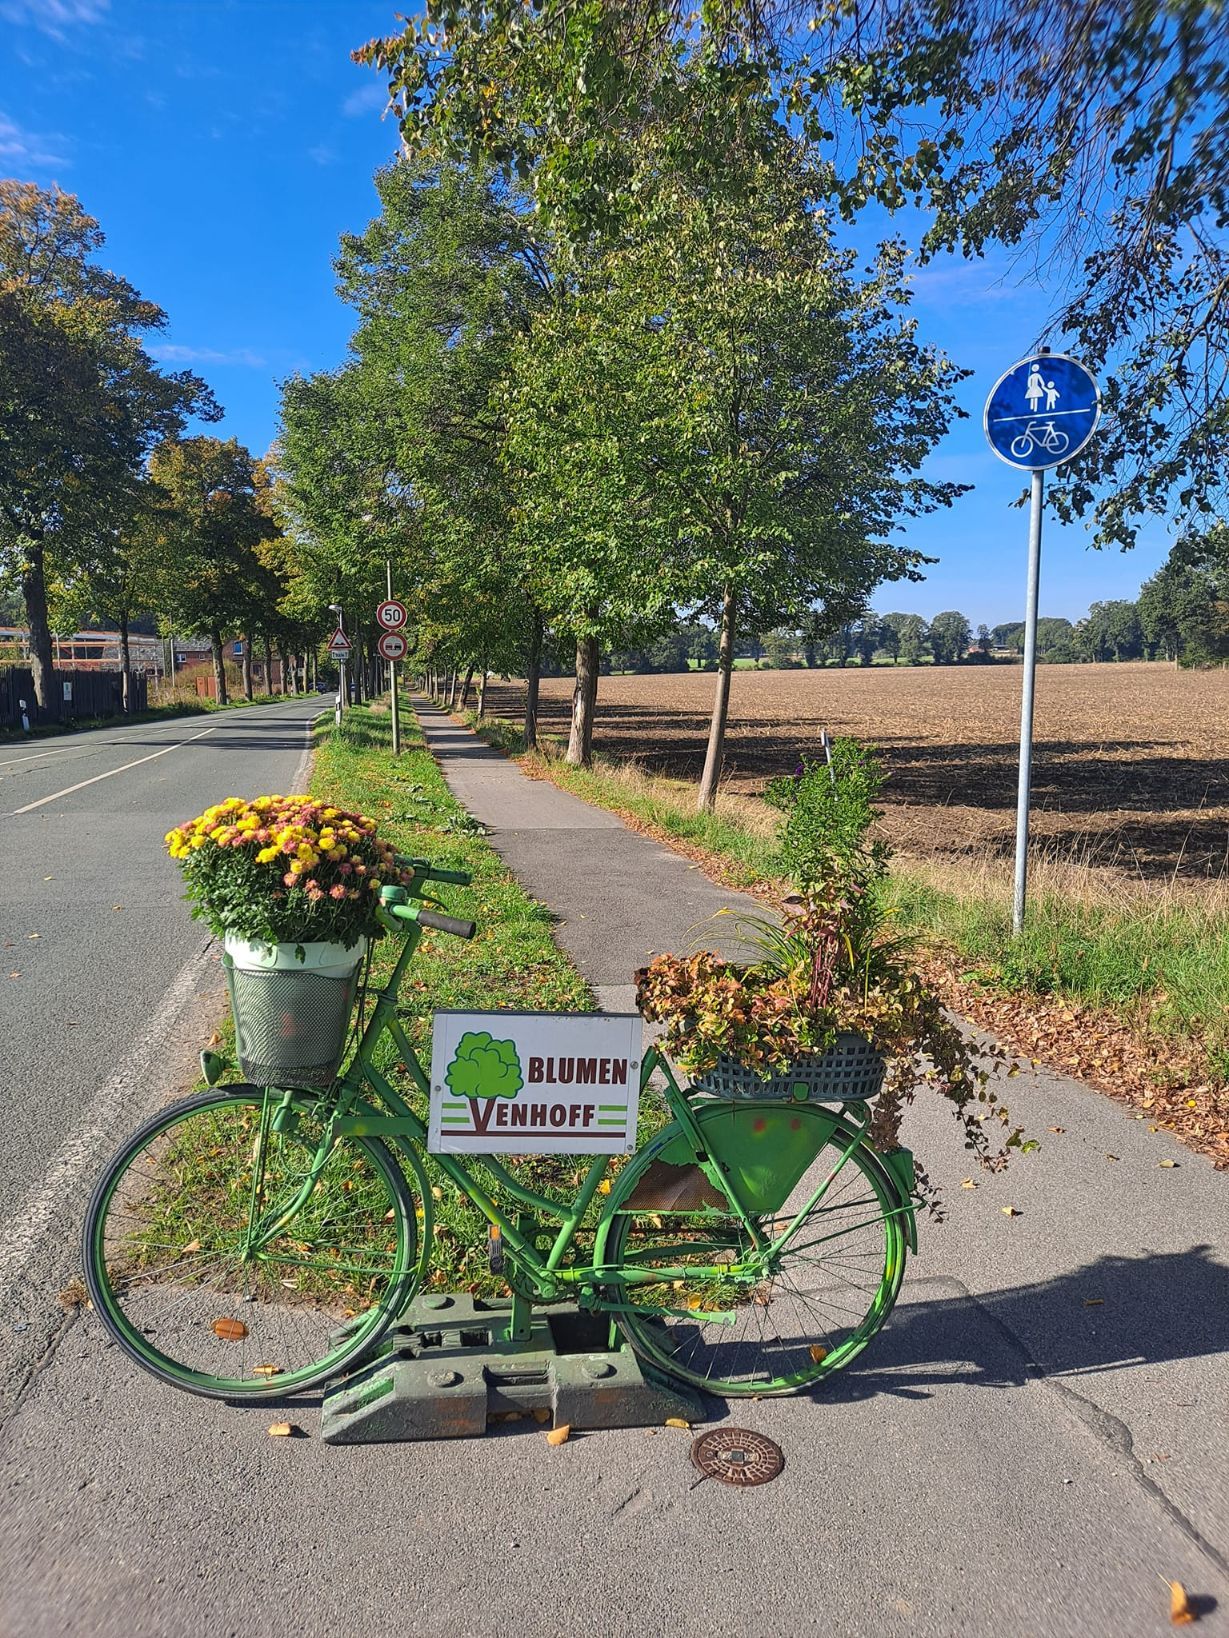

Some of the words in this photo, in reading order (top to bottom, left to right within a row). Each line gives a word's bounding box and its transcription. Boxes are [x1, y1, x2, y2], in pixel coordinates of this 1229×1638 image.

[384, 609, 401, 622] 50
[527, 1057, 628, 1085] BLUMEN
[468, 1098, 596, 1132] VENHOFF
